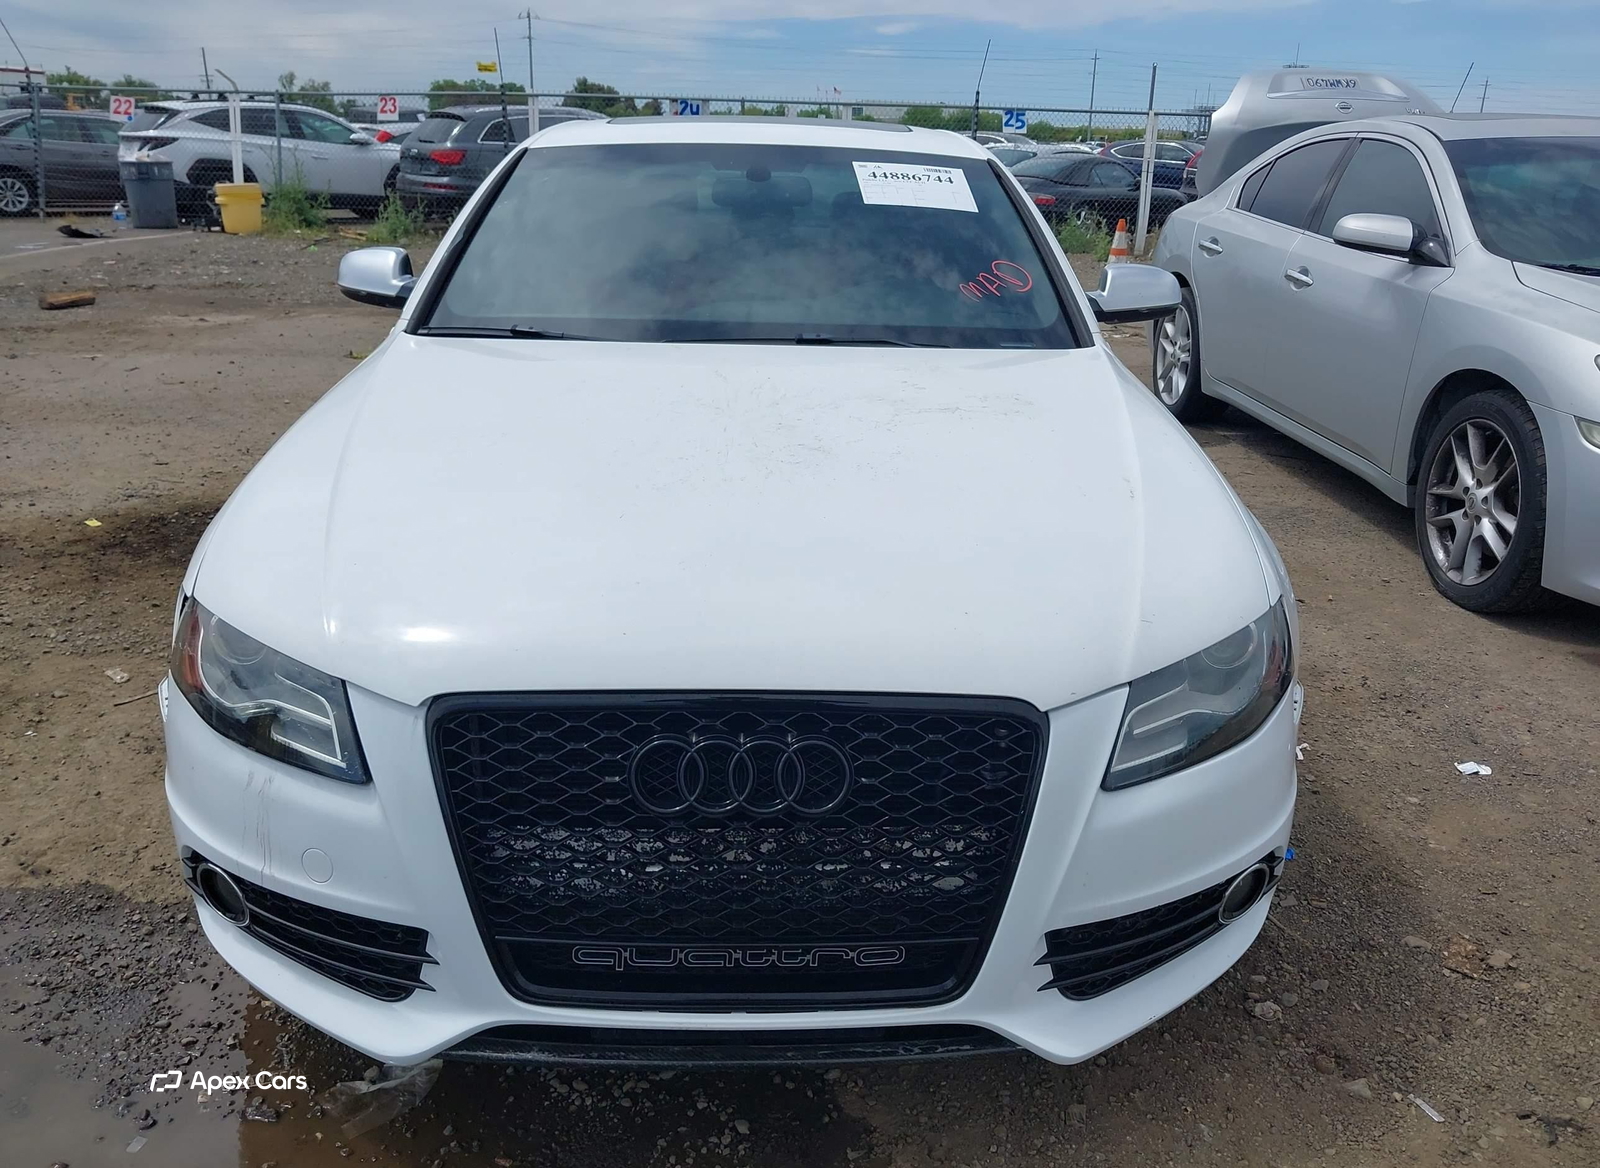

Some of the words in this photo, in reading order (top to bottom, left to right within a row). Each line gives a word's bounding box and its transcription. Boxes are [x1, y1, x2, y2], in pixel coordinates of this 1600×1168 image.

[113, 99, 133, 116] 22
[379, 96, 398, 114] 23
[1004, 110, 1026, 130] 25
[868, 171, 954, 185] 44886744
[571, 945, 906, 971] quattro
